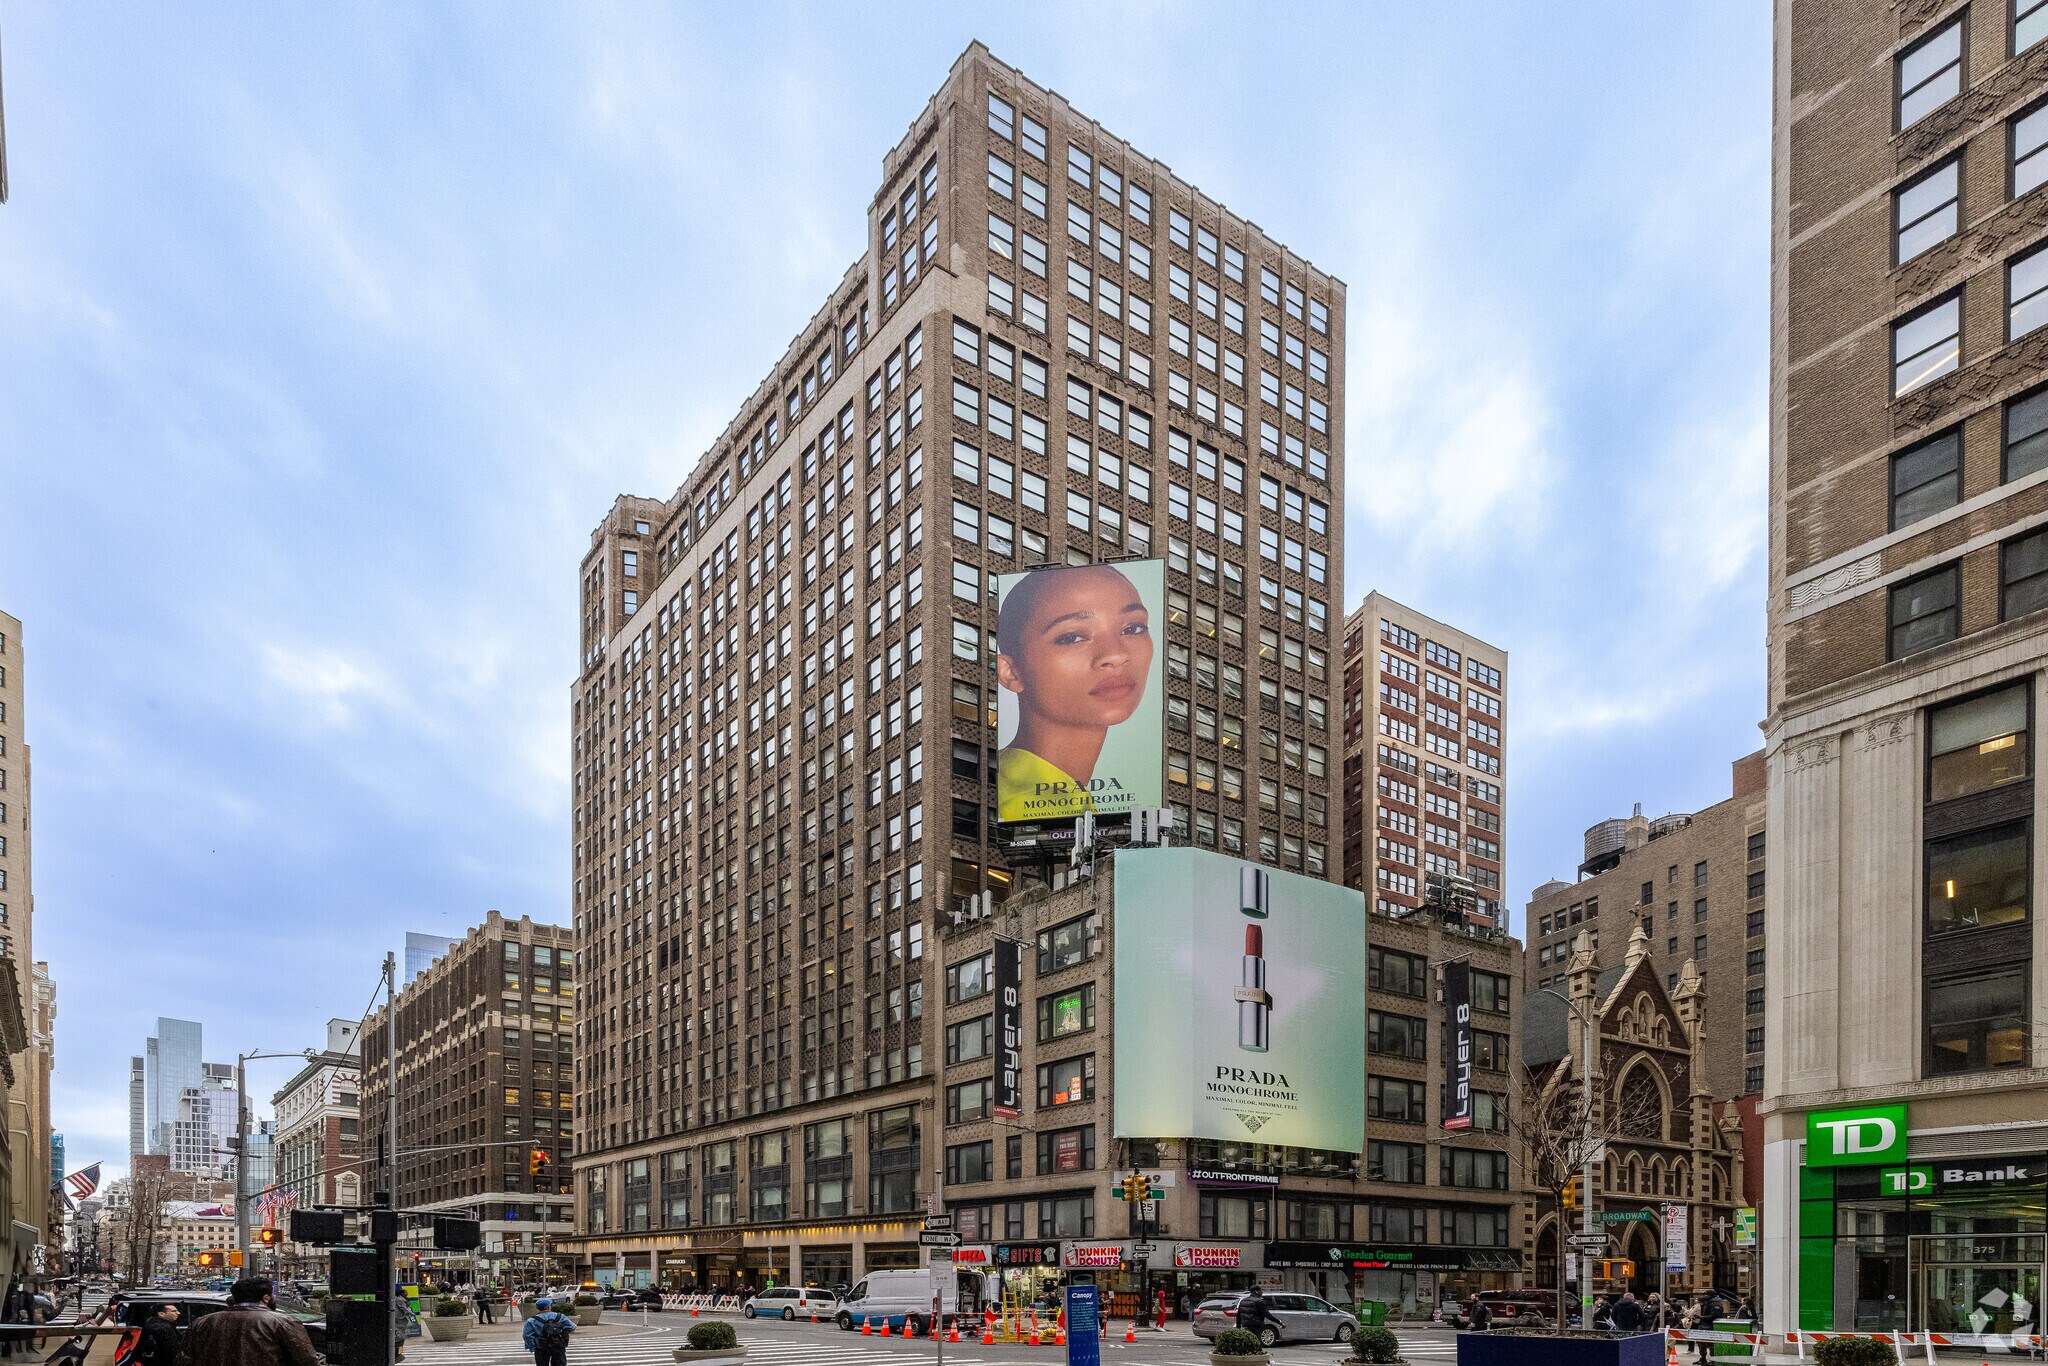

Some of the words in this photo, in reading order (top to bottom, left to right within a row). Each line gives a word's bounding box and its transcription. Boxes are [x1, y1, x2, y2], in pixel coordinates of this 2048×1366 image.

[1035, 777, 1124, 796] PRADA
[1023, 793, 1136, 809] MONOCHROME
[1004, 985, 1017, 1008] 8
[1457, 1003, 1470, 1024] 8
[1216, 1065, 1290, 1088] PRADA
[1206, 1082, 1299, 1102] MONOCHROME
[1205, 1095, 1234, 1103] MAXIMAL
[1258, 1101, 1283, 1109] MINIMAL
[1816, 1117, 1897, 1155] TD
[1192, 1169, 1279, 1184] #OUTFRONTPRIME
[1885, 1172, 1927, 1191] TD
[1943, 1165, 2028, 1183] Bank
[1141, 1203, 1153, 1212] 25
[1602, 1212, 1648, 1220] BROADWAY
[959, 1249, 986, 1262] PIZZA
[1010, 1247, 1042, 1263] GIFTS
[1079, 1246, 1122, 1257] DUNKIN'
[1194, 1247, 1242, 1257] DUNKIN'
[1342, 1249, 1374, 1260] Garden
[1376, 1250, 1413, 1260] Gourmet
[1079, 1256, 1120, 1267] DONUTS
[1194, 1257, 1240, 1267] DONUTS
